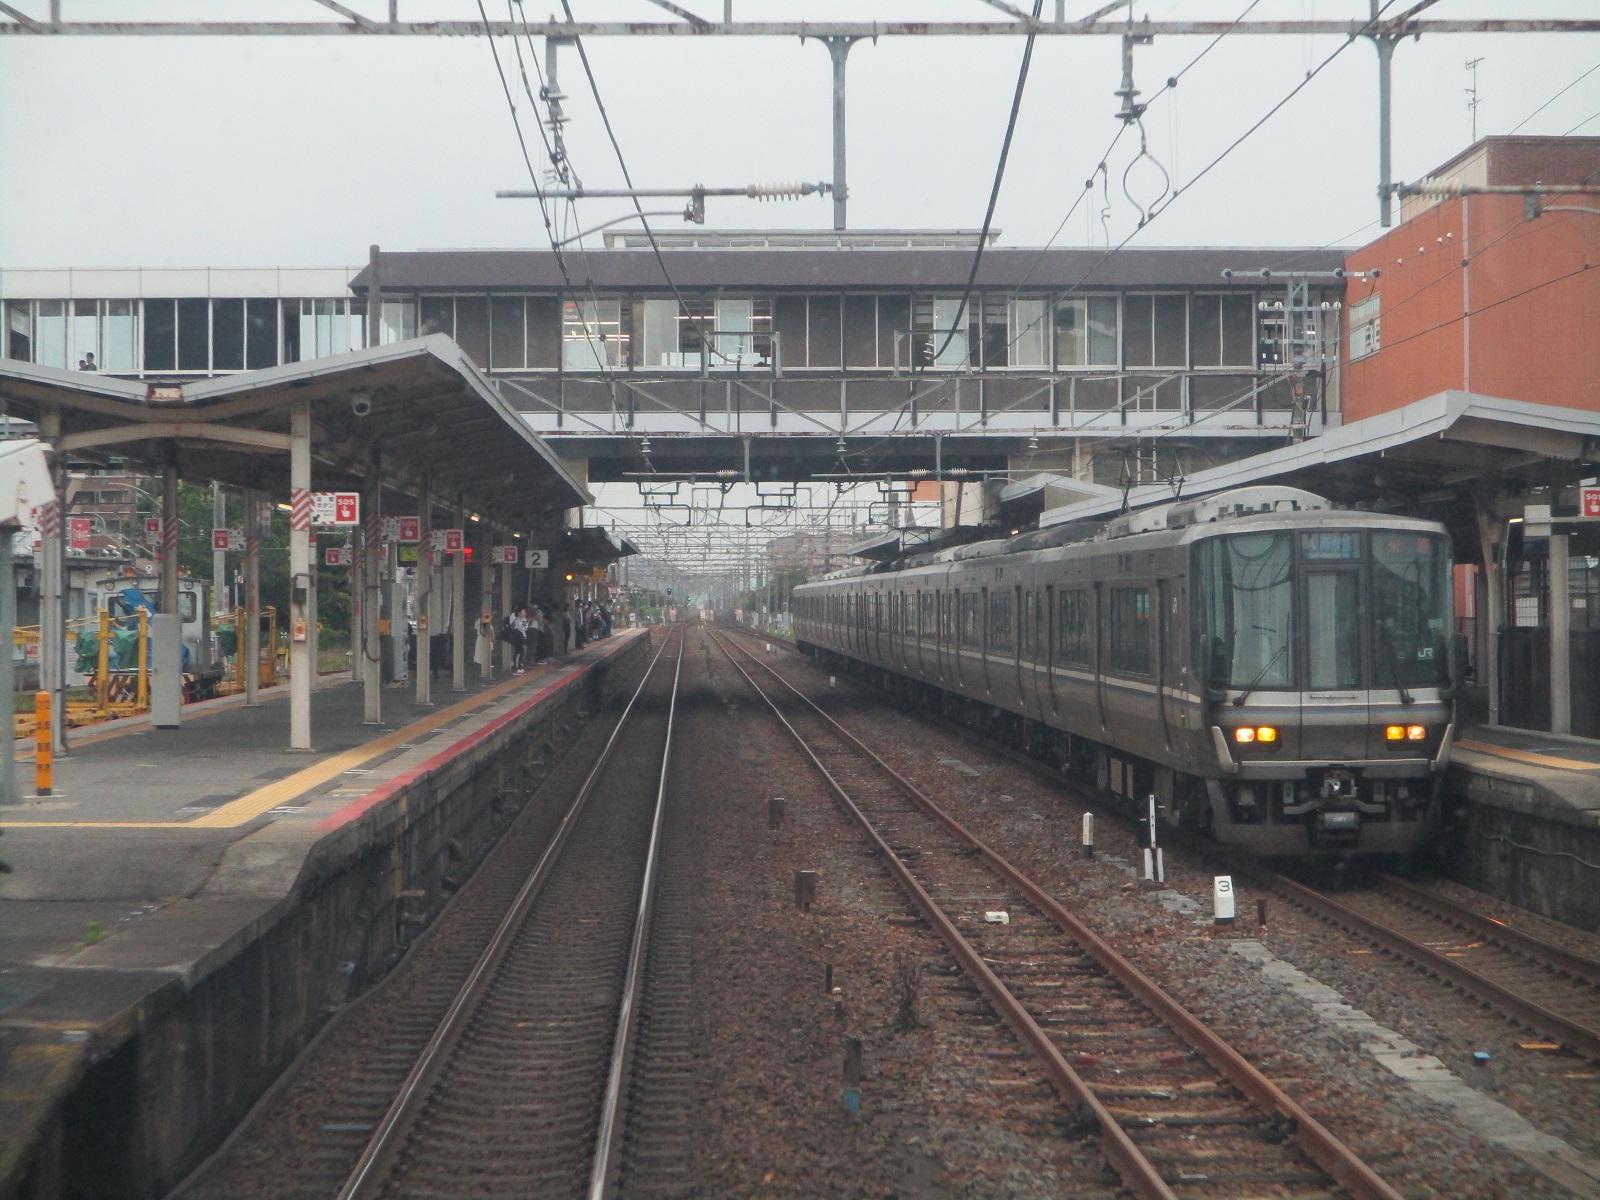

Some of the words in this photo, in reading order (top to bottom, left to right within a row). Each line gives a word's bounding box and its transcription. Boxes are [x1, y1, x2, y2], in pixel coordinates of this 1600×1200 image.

[531, 552, 541, 566] 2
[1418, 648, 1433, 658] JR
[1218, 880, 1230, 892] 3
